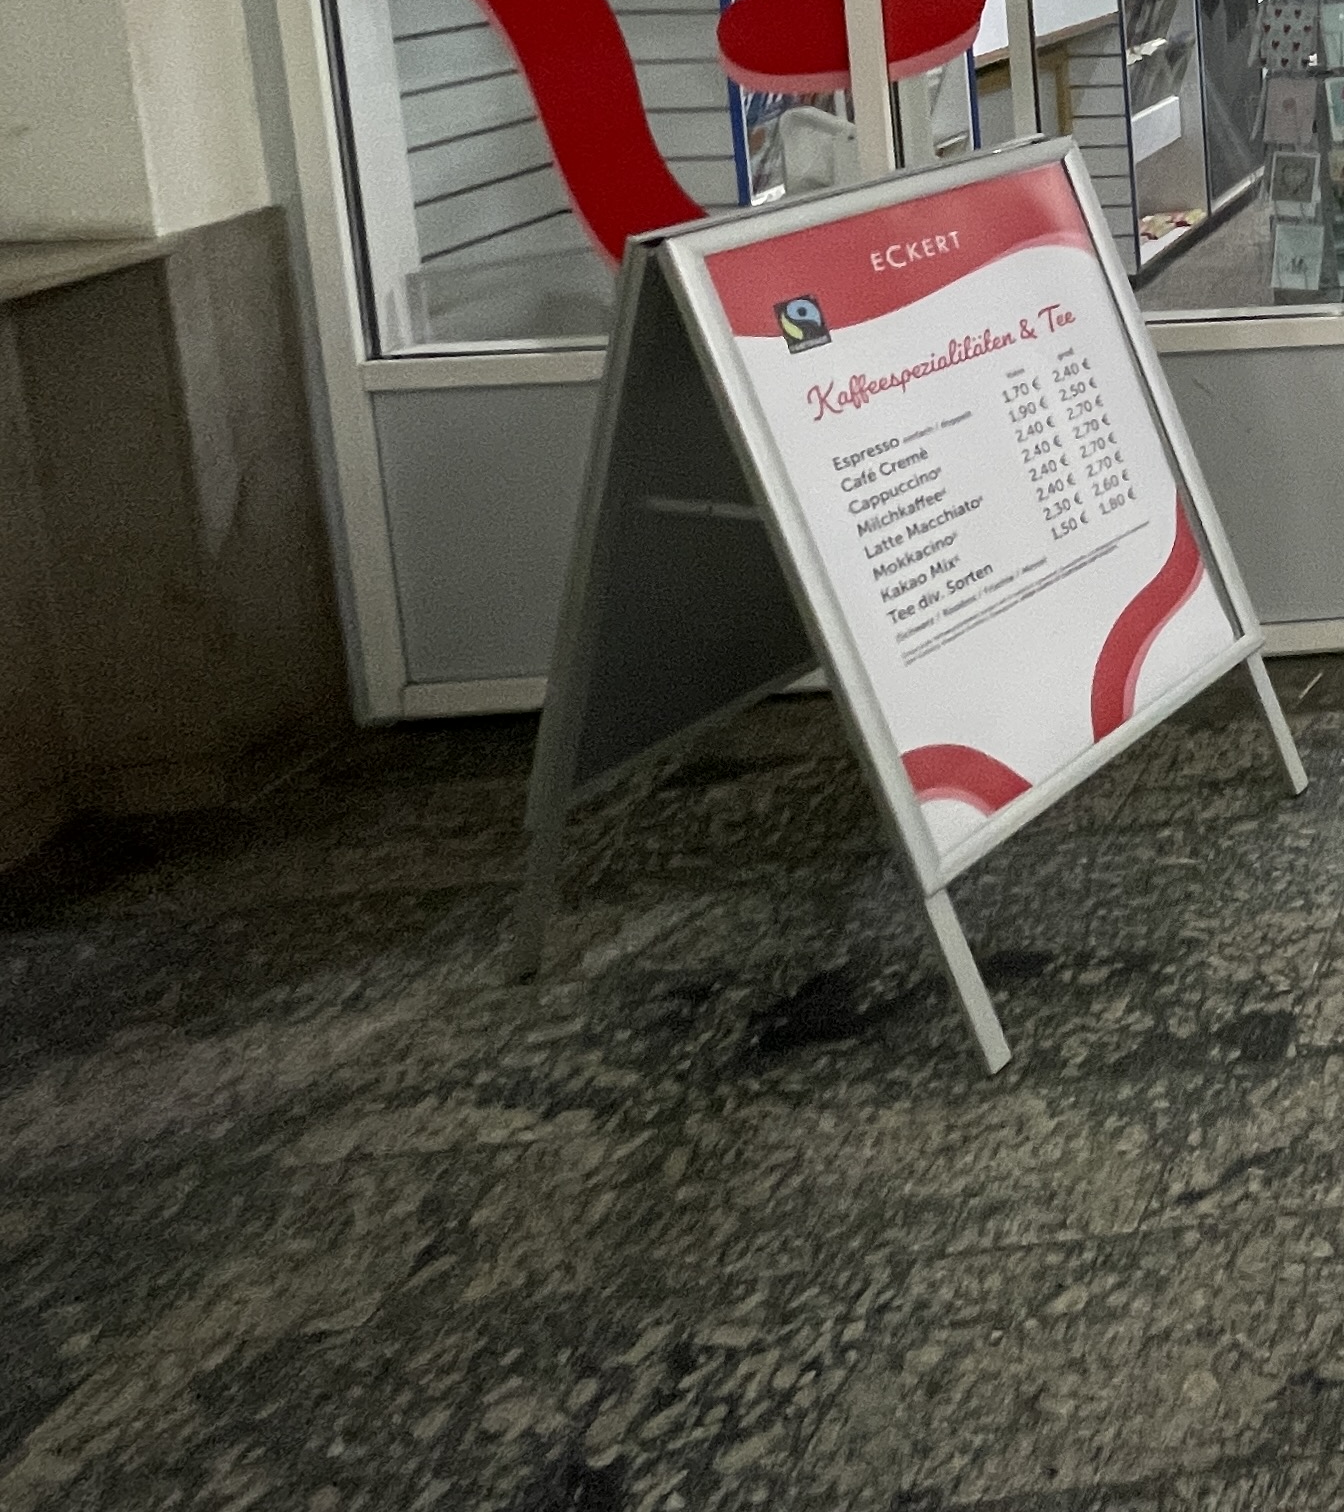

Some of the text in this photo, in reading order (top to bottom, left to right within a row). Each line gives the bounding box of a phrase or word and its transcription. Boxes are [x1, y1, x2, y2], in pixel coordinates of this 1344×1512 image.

[869, 230, 962, 272] ECKERT
[806, 328, 1017, 422] Kaffeespezialitäten
[1019, 318, 1038, 341] &
[1037, 303, 1078, 333] Tee
[831, 437, 901, 472] Espresso
[840, 468, 877, 493] Café
[864, 534, 905, 559] Latte
[880, 573, 928, 603] Kakao
[887, 604, 916, 625] Tee
[918, 590, 945, 609] div.
[946, 564, 994, 595] Sorten
